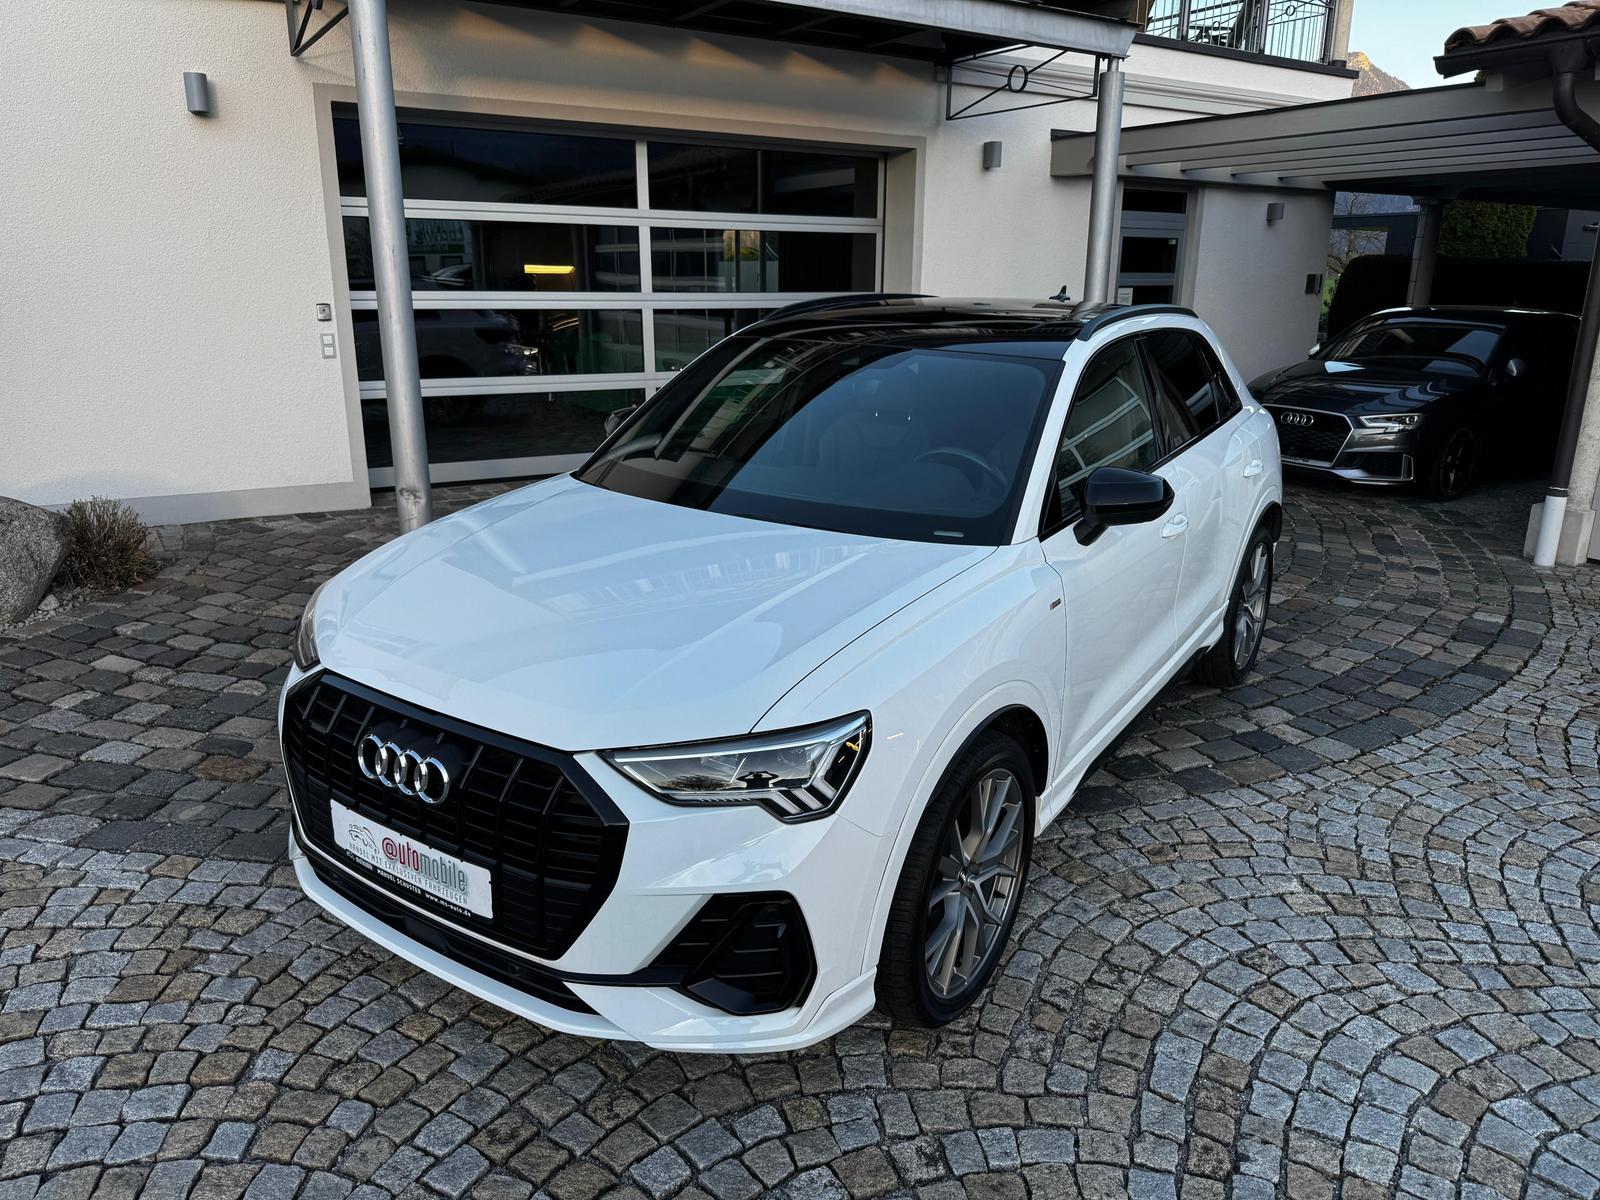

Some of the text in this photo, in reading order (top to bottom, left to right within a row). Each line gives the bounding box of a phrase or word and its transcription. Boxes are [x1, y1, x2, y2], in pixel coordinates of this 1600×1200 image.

[349, 842, 369, 859] HANDEL
[371, 854, 382, 865] MIT
[384, 860, 423, 885] EXKLUSIVEN
[424, 879, 469, 905] FAHRZEUGEN
[376, 868, 396, 883] MANUEL
[396, 878, 422, 895] SCHUSTER
[382, 837, 467, 891] @utomobile
